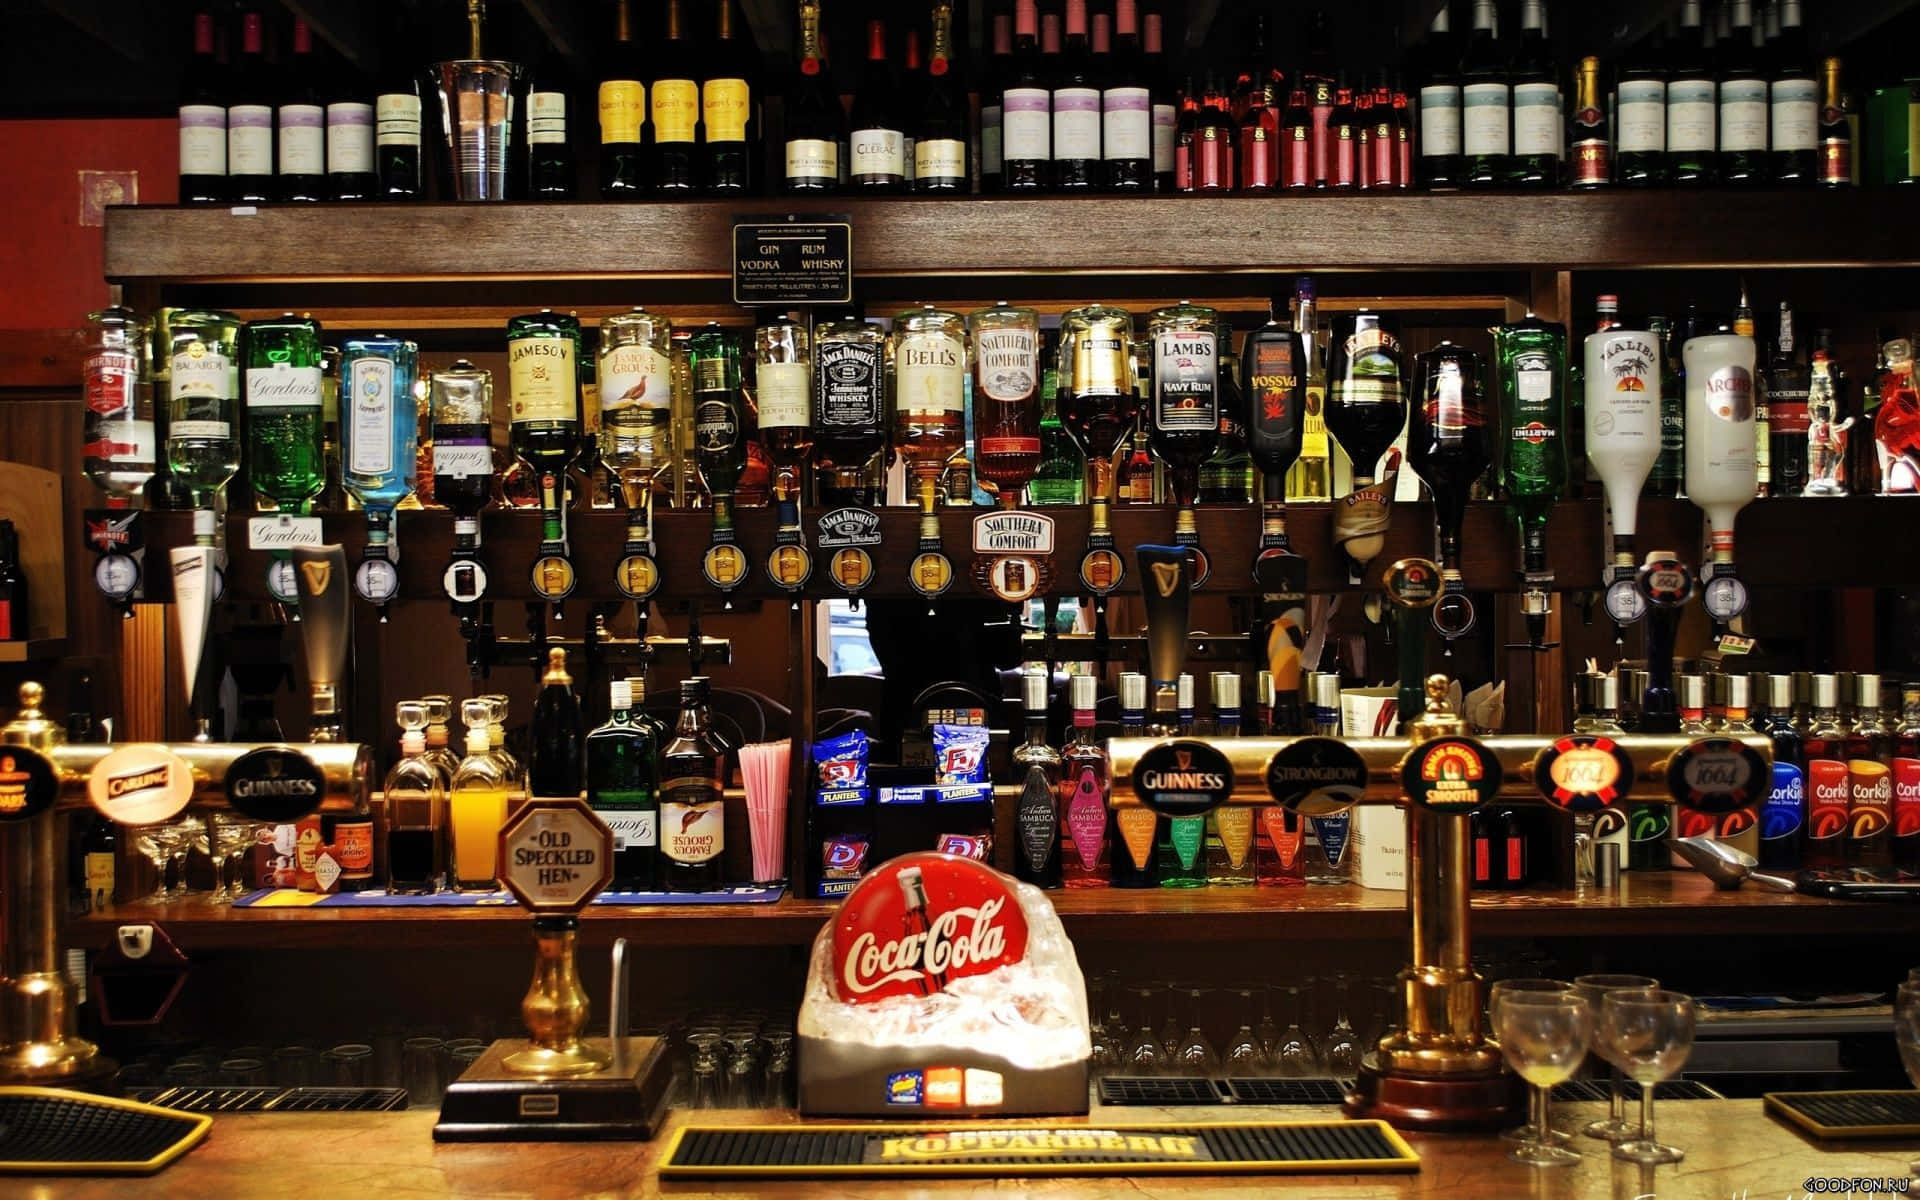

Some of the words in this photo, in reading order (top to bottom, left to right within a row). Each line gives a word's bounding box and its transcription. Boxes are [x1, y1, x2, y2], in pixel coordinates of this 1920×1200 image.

[759, 245, 780, 255] GIN
[801, 245, 825, 255] RUM
[740, 260, 781, 270] VODKA
[801, 259, 844, 270] WHISKY
[980, 334, 1033, 355] SOUTHERN
[1163, 342, 1212, 357] LAMB'S
[1599, 340, 1657, 364] MALIBU
[512, 344, 569, 363] JAMESON
[614, 352, 656, 363] FAMOUS
[823, 348, 843, 367] JACK
[843, 346, 876, 367] DANIEL'S
[904, 348, 957, 367] BELL'S
[985, 353, 1032, 368] COMFORT
[175, 360, 223, 372] BACARDI
[612, 363, 657, 374] GROUSE
[253, 374, 319, 398] Gordon's
[1163, 382, 1190, 393] NAVY
[1191, 382, 1212, 393] RUM
[828, 394, 870, 402] WHISKEY
[1515, 429, 1556, 438] MARTINI
[1348, 491, 1387, 505] BAILEYS
[824, 513, 844, 529] JACK
[843, 510, 874, 527] DANIEL'S
[984, 516, 1045, 535] SOUTHERN
[90, 531, 129, 544] SMIRNOFF
[254, 524, 322, 545] Gordon's
[989, 535, 1040, 550] COMFORT
[108, 768, 169, 797] CARLING
[1142, 769, 1225, 790] GUINNESS
[1272, 766, 1359, 784] STRONGBOW
[235, 778, 317, 797] GUINNESS
[942, 788, 980, 800] PLANTERS
[822, 791, 861, 803] PLANTERS
[1425, 789, 1479, 804] SMOOTH
[1020, 814, 1055, 823] SAMBUCA
[537, 829, 571, 848] OLD
[671, 834, 714, 845] GROUSE
[514, 848, 596, 866] SPECKLED
[674, 844, 712, 855] FAMOUS
[537, 866, 572, 886] HEN
[845, 897, 1006, 994] Coca-Cola
[879, 1132, 1200, 1158] KOPPARBERG
